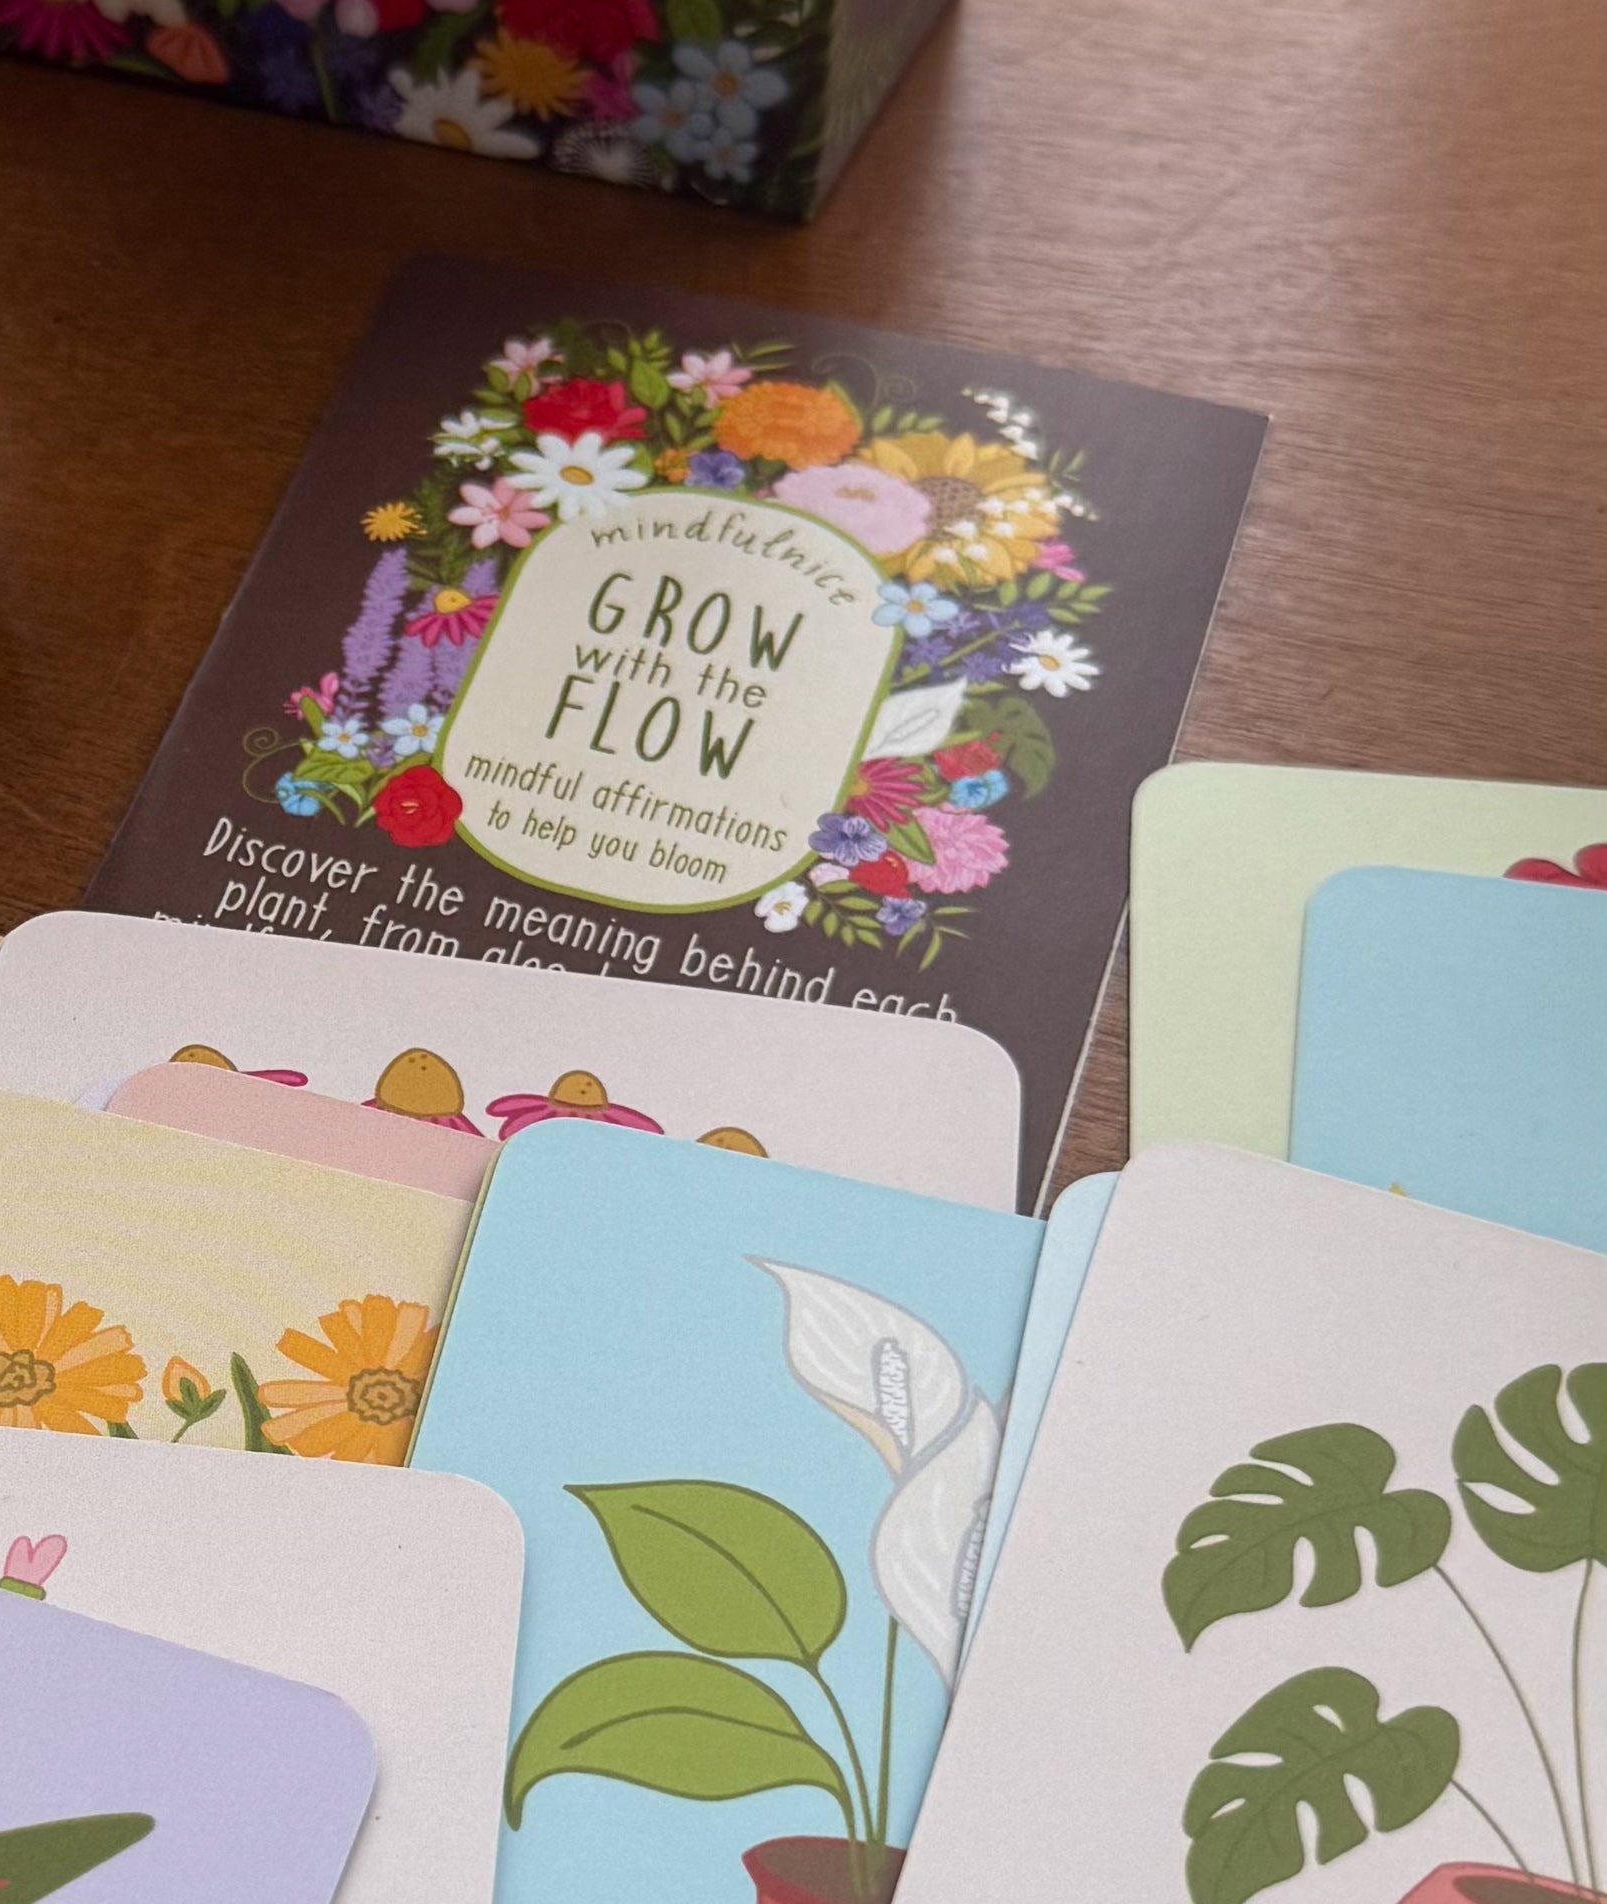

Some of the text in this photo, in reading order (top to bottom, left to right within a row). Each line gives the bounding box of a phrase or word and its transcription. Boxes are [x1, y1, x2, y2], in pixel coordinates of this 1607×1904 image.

[592, 511, 857, 607] mindfulnice
[588, 572, 804, 672] GROW
[575, 644, 767, 709] with the
[545, 674, 755, 780] FLOW
[465, 750, 787, 853] mindful affirmations
[488, 801, 728, 884] to help you bloom
[203, 817, 379, 895] Discover
[395, 863, 465, 915] the
[484, 896, 661, 975] meaning
[679, 934, 836, 1005] behind
[214, 877, 334, 941] plant,
[360, 903, 461, 958] from
